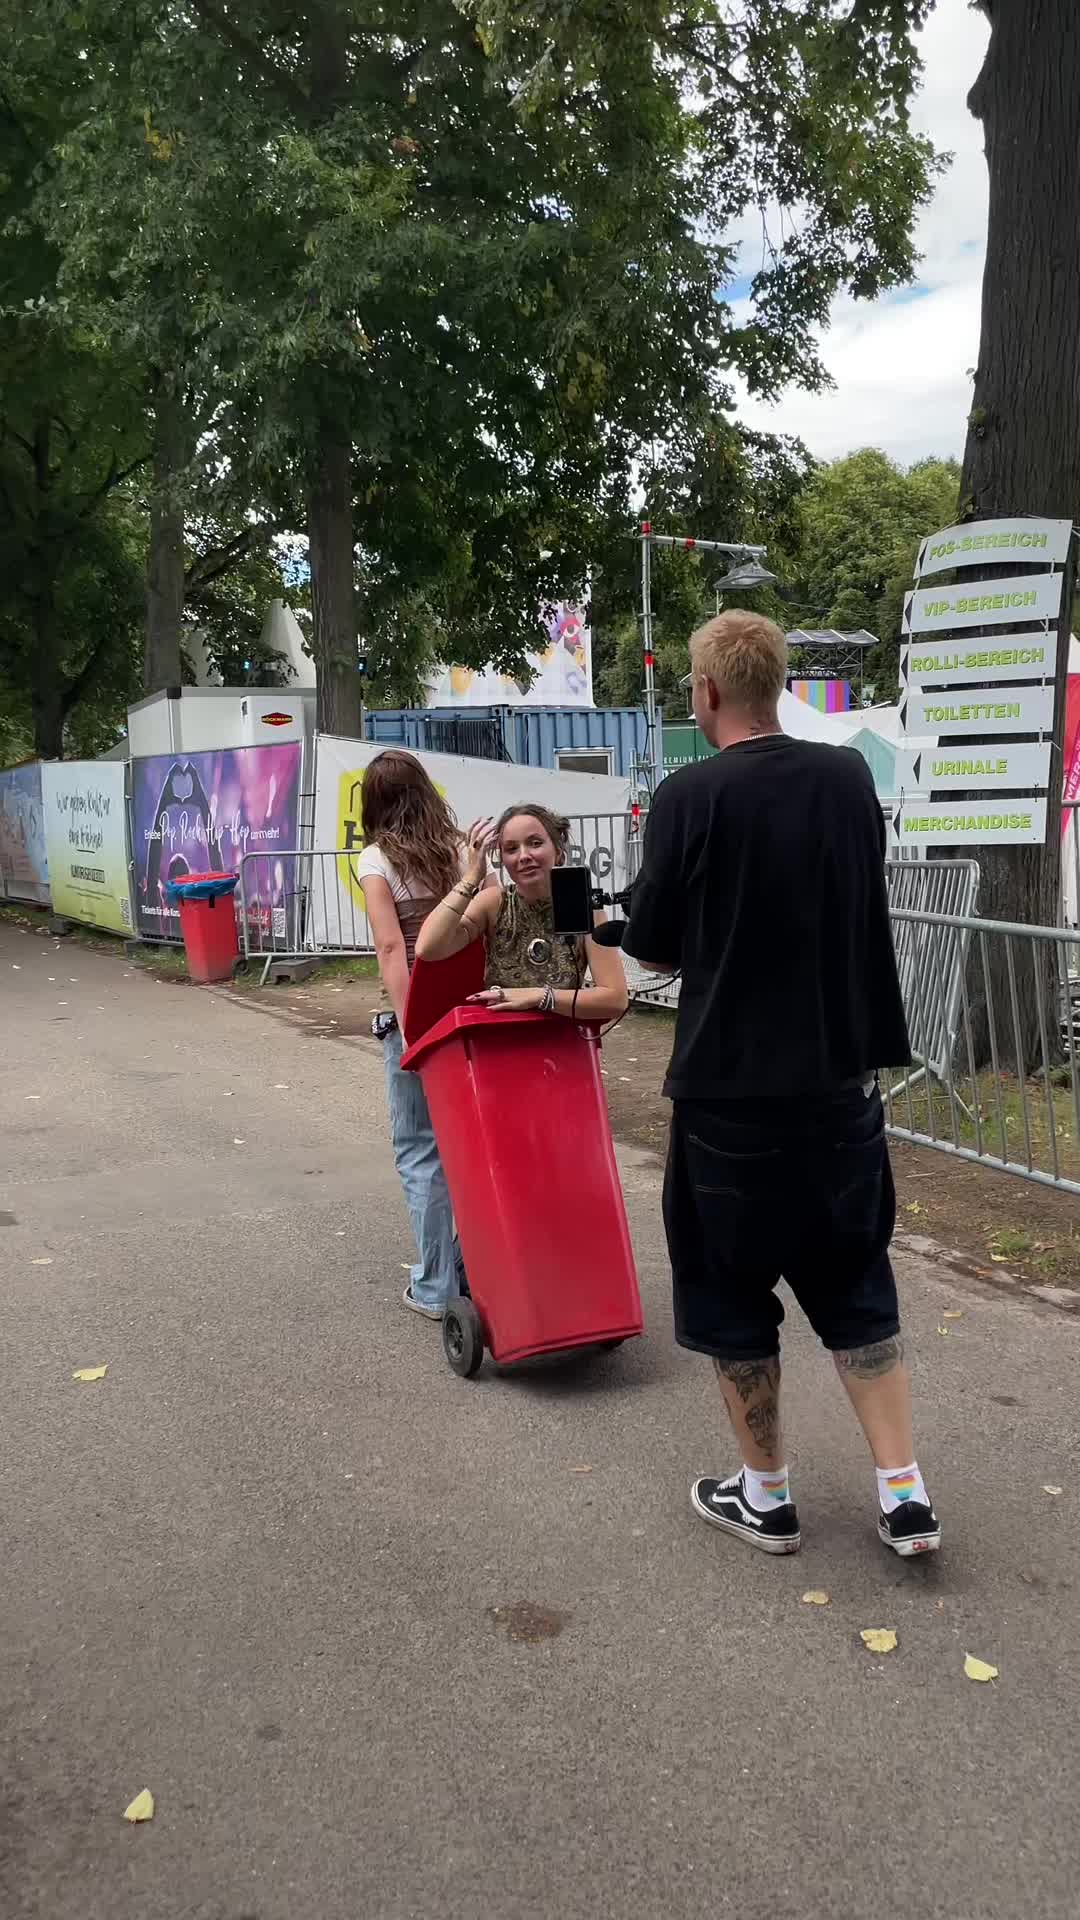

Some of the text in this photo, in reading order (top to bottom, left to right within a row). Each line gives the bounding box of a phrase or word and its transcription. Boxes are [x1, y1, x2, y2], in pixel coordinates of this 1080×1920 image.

[924, 591, 1037, 616] VIP-BEREICH
[910, 647, 1044, 672] ROLLI-BEREICH
[923, 703, 1020, 722] TOILETTEN
[663, 756, 693, 765] REMIUM
[931, 759, 1008, 777] URINALE
[903, 812, 1033, 832] MERCHANDISE
